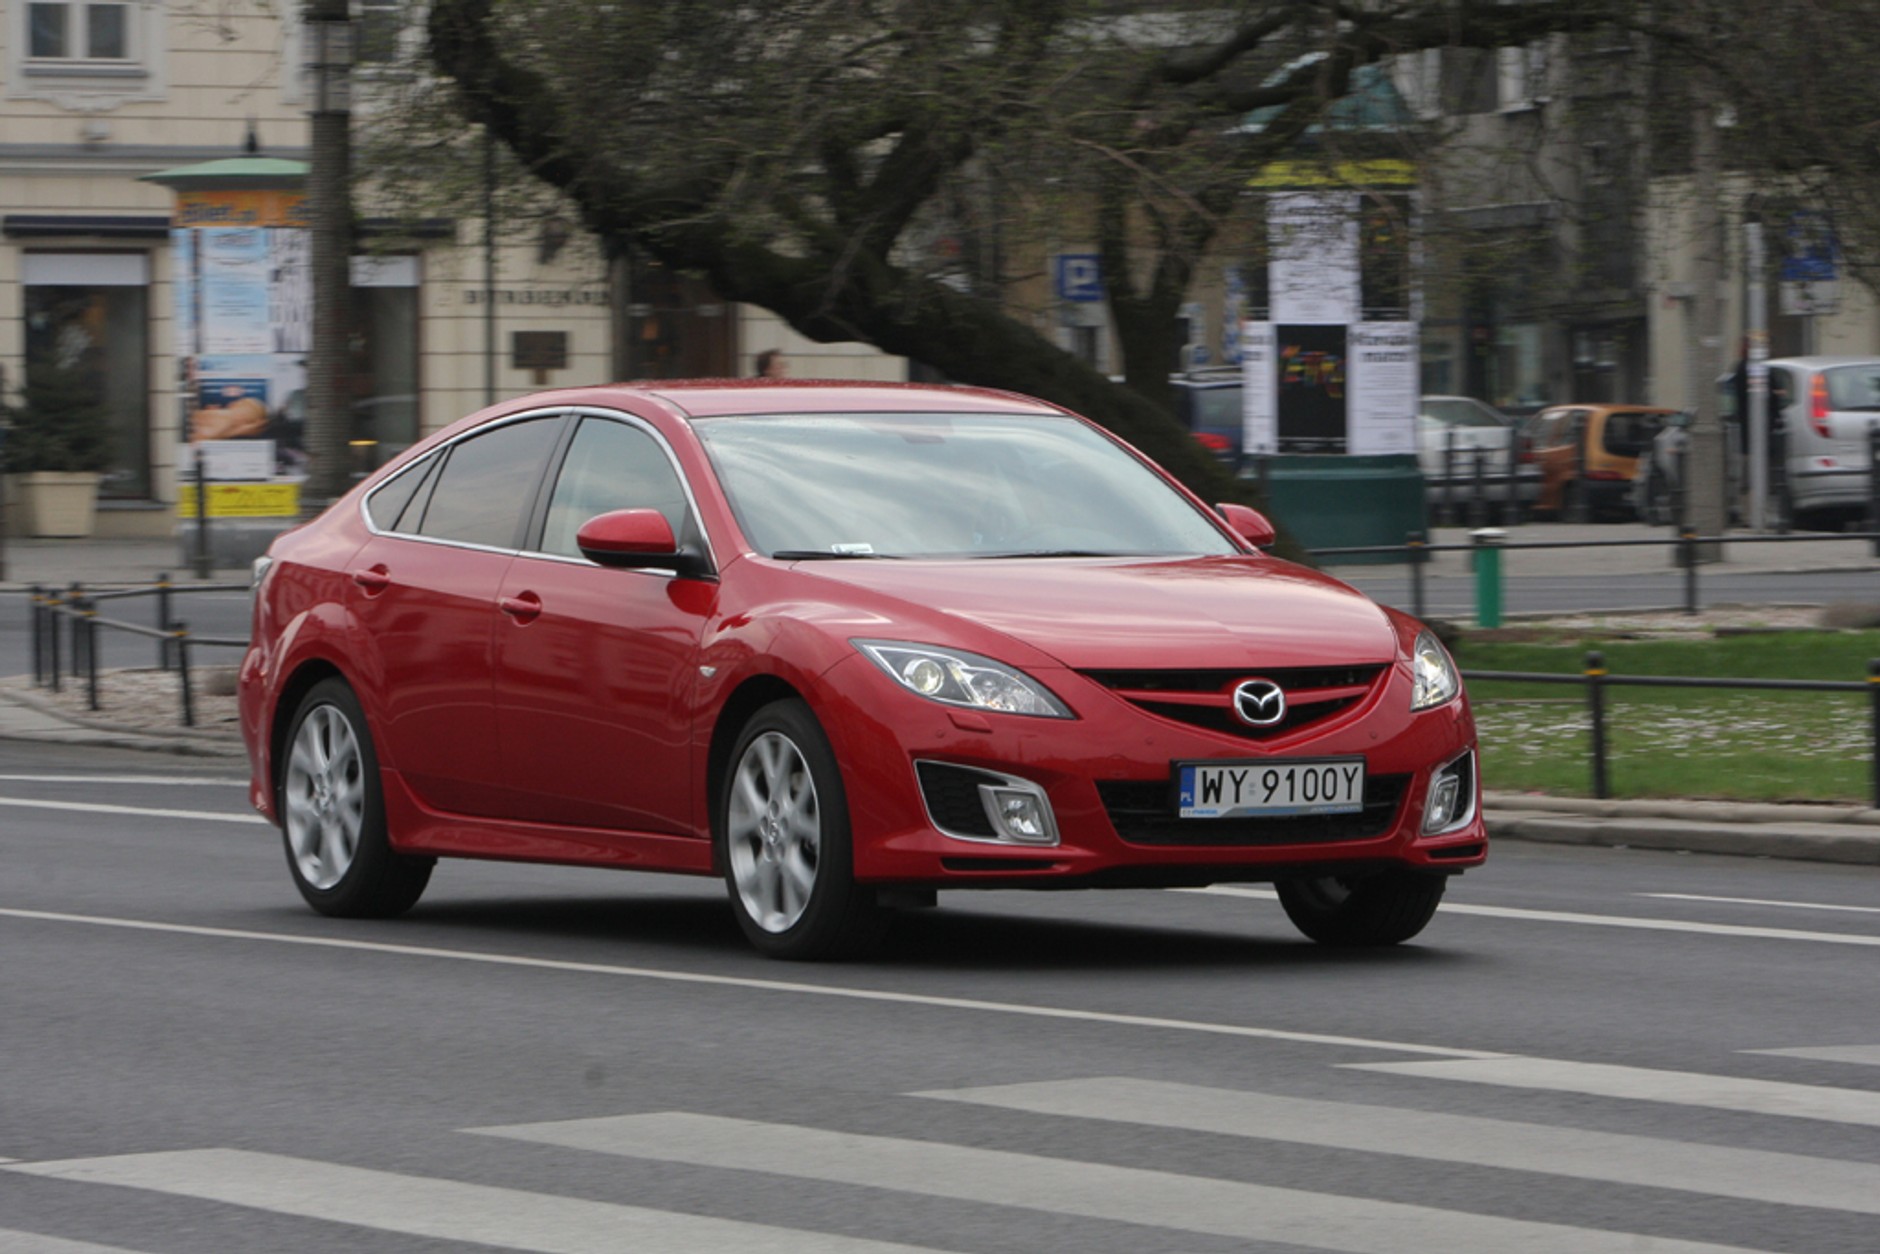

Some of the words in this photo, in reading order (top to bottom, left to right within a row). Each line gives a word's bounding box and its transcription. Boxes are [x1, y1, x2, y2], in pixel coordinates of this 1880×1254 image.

[1064, 258, 1098, 295] P
[1181, 792, 1192, 802] PL
[1202, 769, 1248, 804] WY
[1262, 766, 1359, 803] 9100Y
